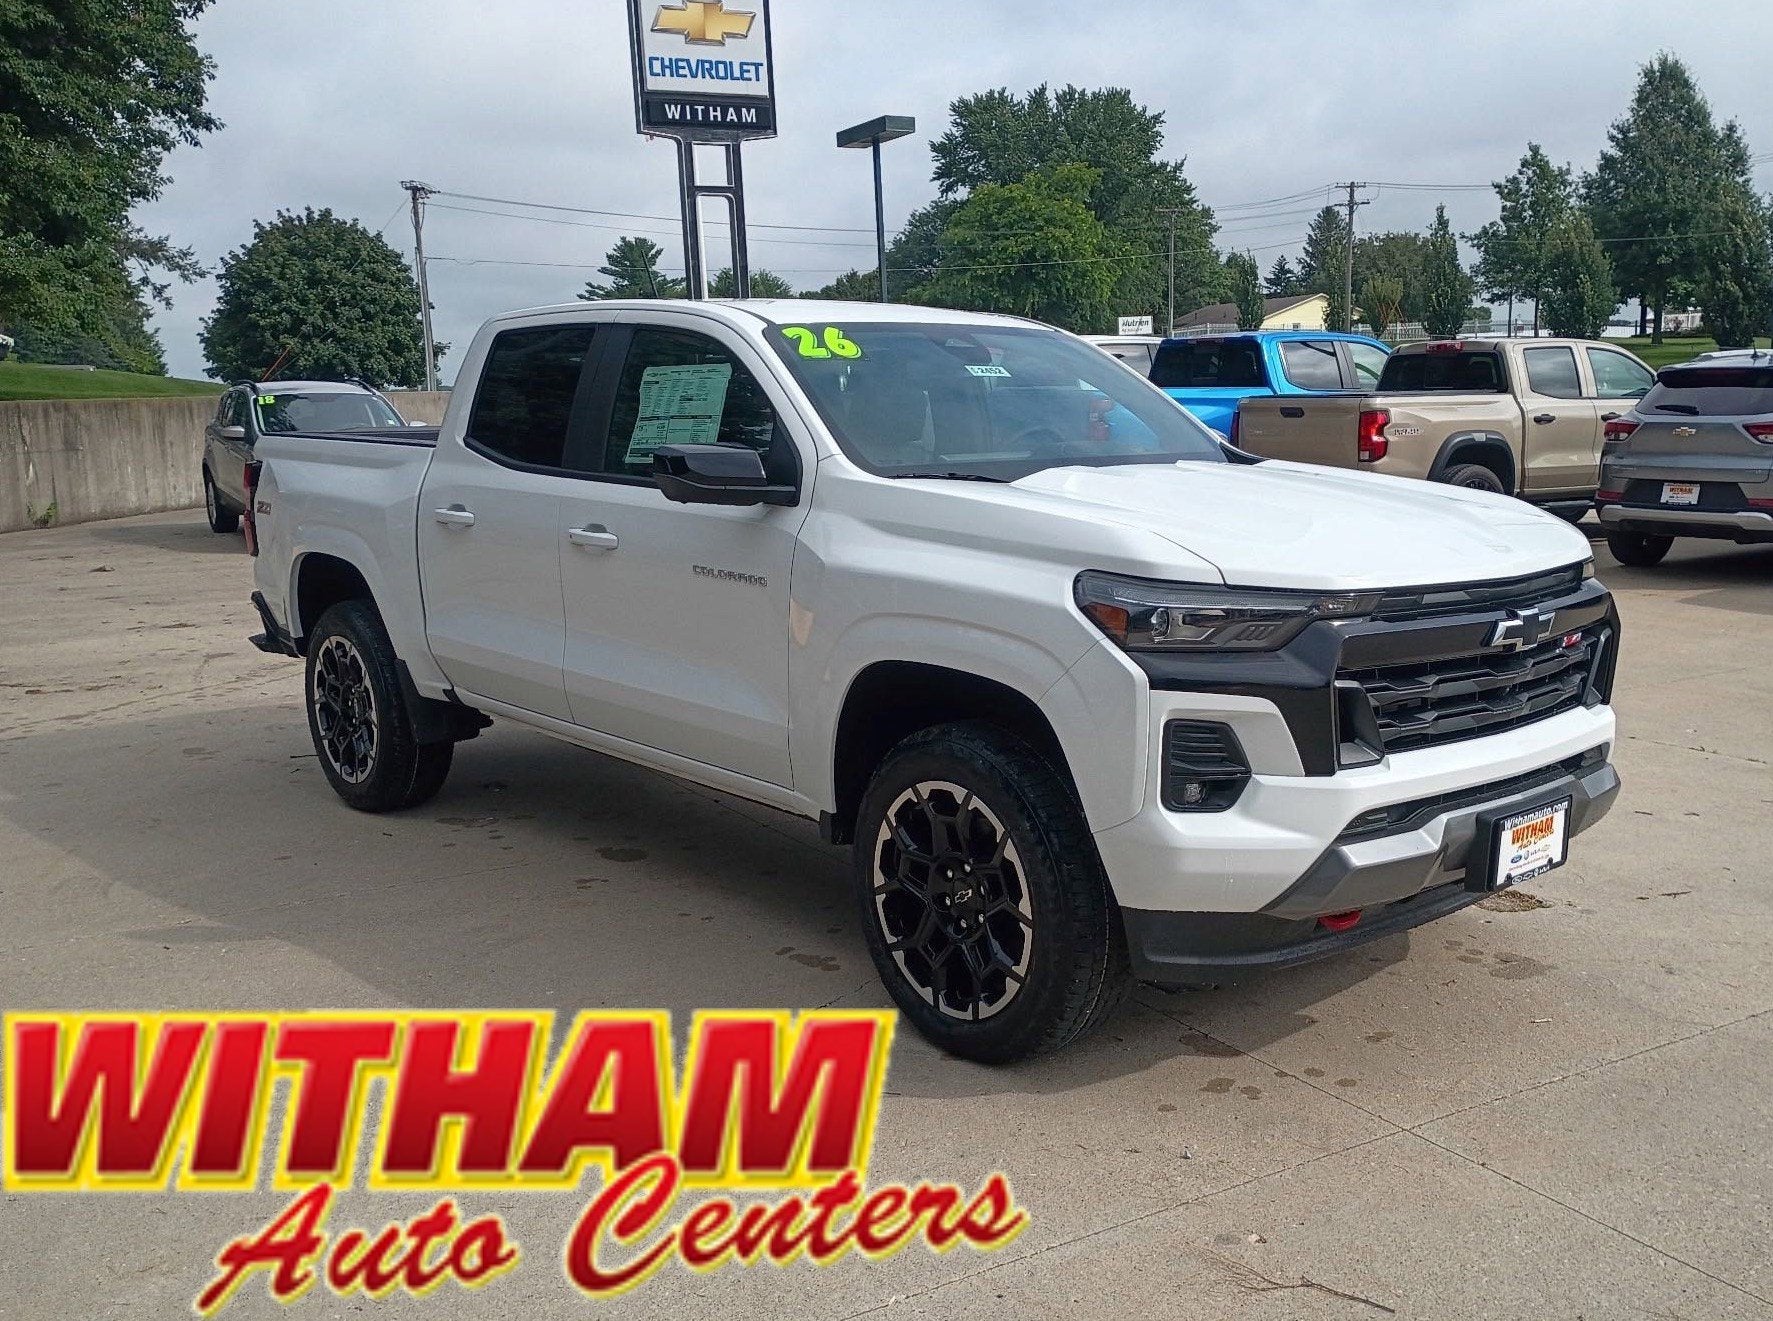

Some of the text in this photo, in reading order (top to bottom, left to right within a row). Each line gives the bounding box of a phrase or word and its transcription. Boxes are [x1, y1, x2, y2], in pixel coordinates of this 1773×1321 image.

[648, 56, 764, 82] CHEVROLET
[664, 103, 757, 123] WITHAM
[782, 326, 862, 359] 26
[257, 395, 275, 405] 18
[692, 564, 768, 588] COLORADO
[1504, 801, 1568, 831] Withamauto.com
[1511, 816, 1554, 845] WITHAM
